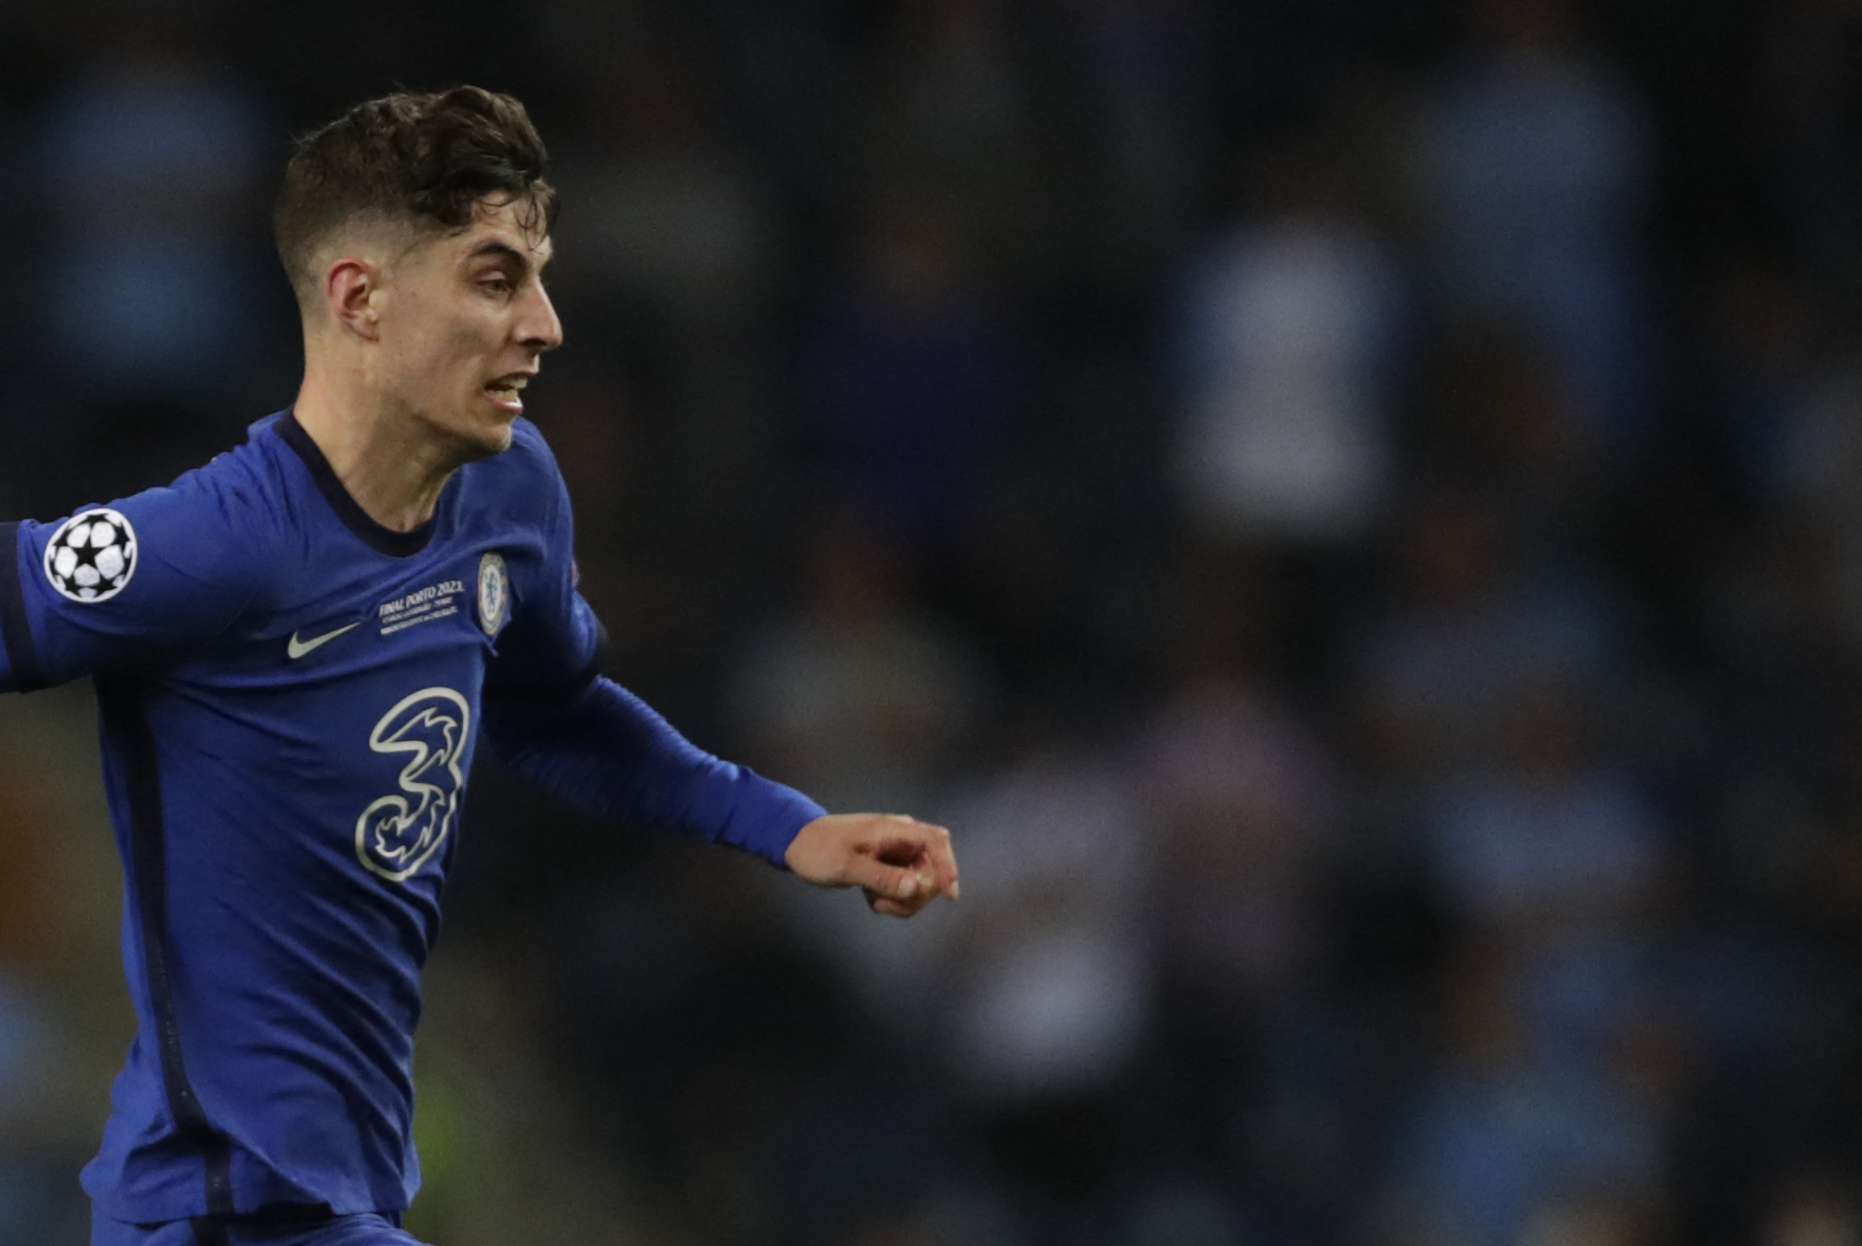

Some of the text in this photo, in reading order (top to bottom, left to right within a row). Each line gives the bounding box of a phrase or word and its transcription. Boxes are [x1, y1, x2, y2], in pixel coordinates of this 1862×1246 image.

[379, 599, 405, 617] FINAL
[406, 586, 436, 608] PORTO
[437, 580, 465, 596] 2021
[355, 687, 469, 881] 3
